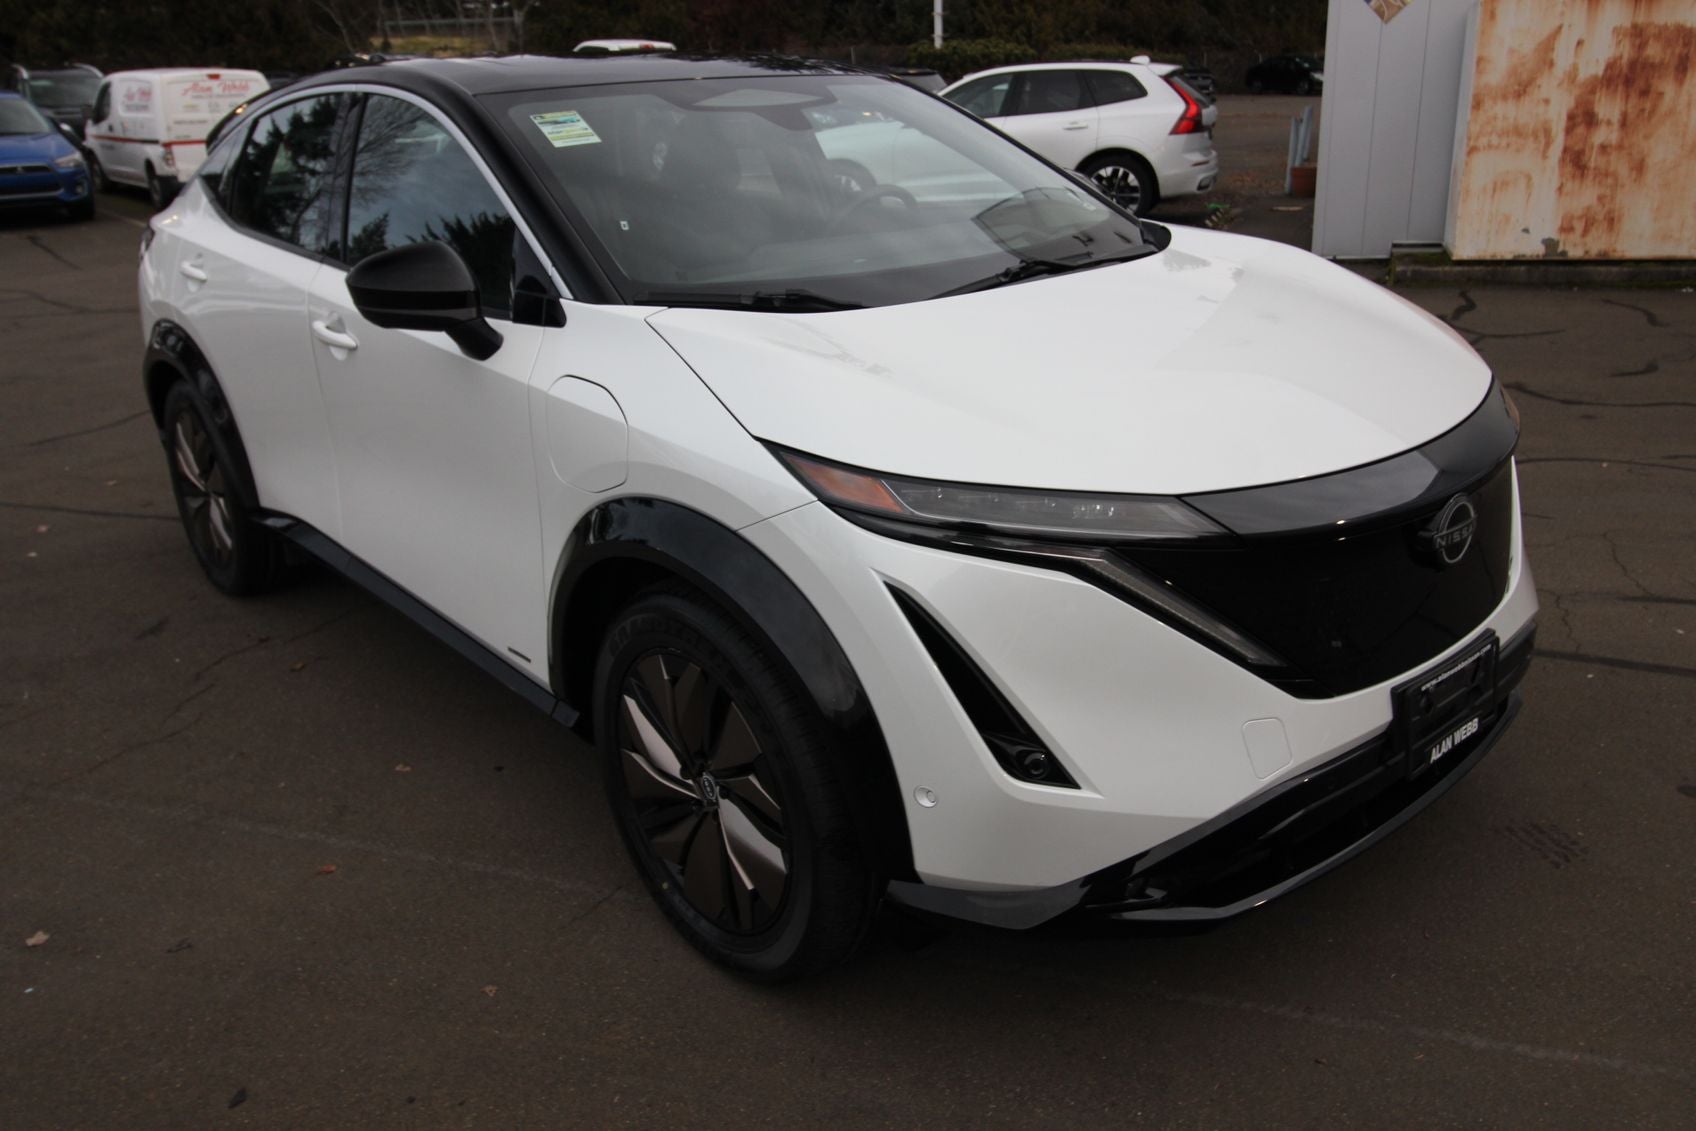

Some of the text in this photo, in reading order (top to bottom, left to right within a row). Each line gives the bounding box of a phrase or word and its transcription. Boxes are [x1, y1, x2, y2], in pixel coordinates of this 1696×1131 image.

[1436, 525, 1473, 548] NISSA
[1430, 718, 1479, 763] ALAN WEBB
